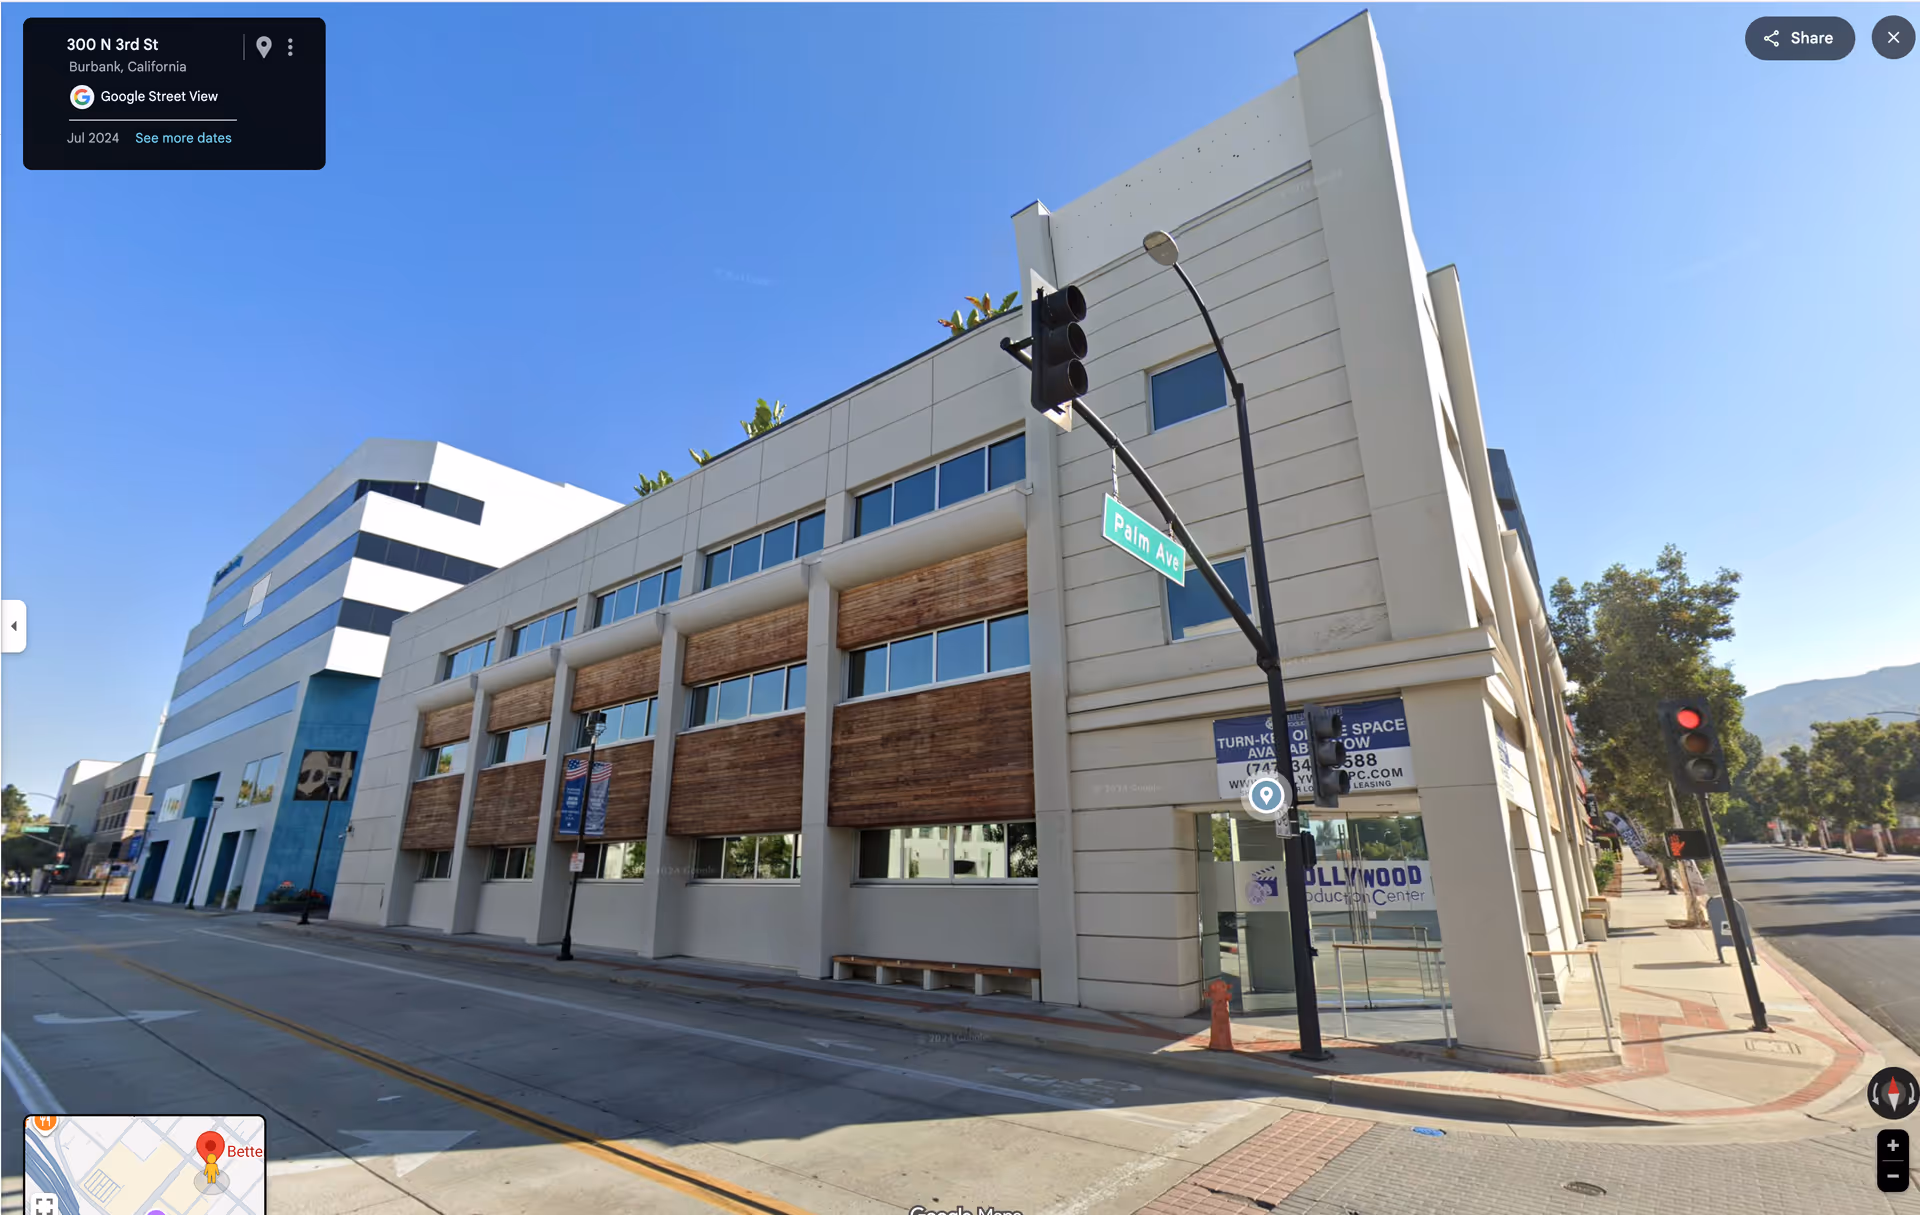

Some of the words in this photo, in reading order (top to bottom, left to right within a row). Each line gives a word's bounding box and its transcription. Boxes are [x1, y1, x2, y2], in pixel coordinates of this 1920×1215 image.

[1114, 512, 1150, 553] Palm
[1156, 542, 1179, 572] Ave
[1217, 732, 1276, 749] TURN-KE
[1352, 718, 1406, 736] SPACE
[1353, 780, 1392, 789] LEASING
[1304, 865, 1422, 888] OLLYWOOD
